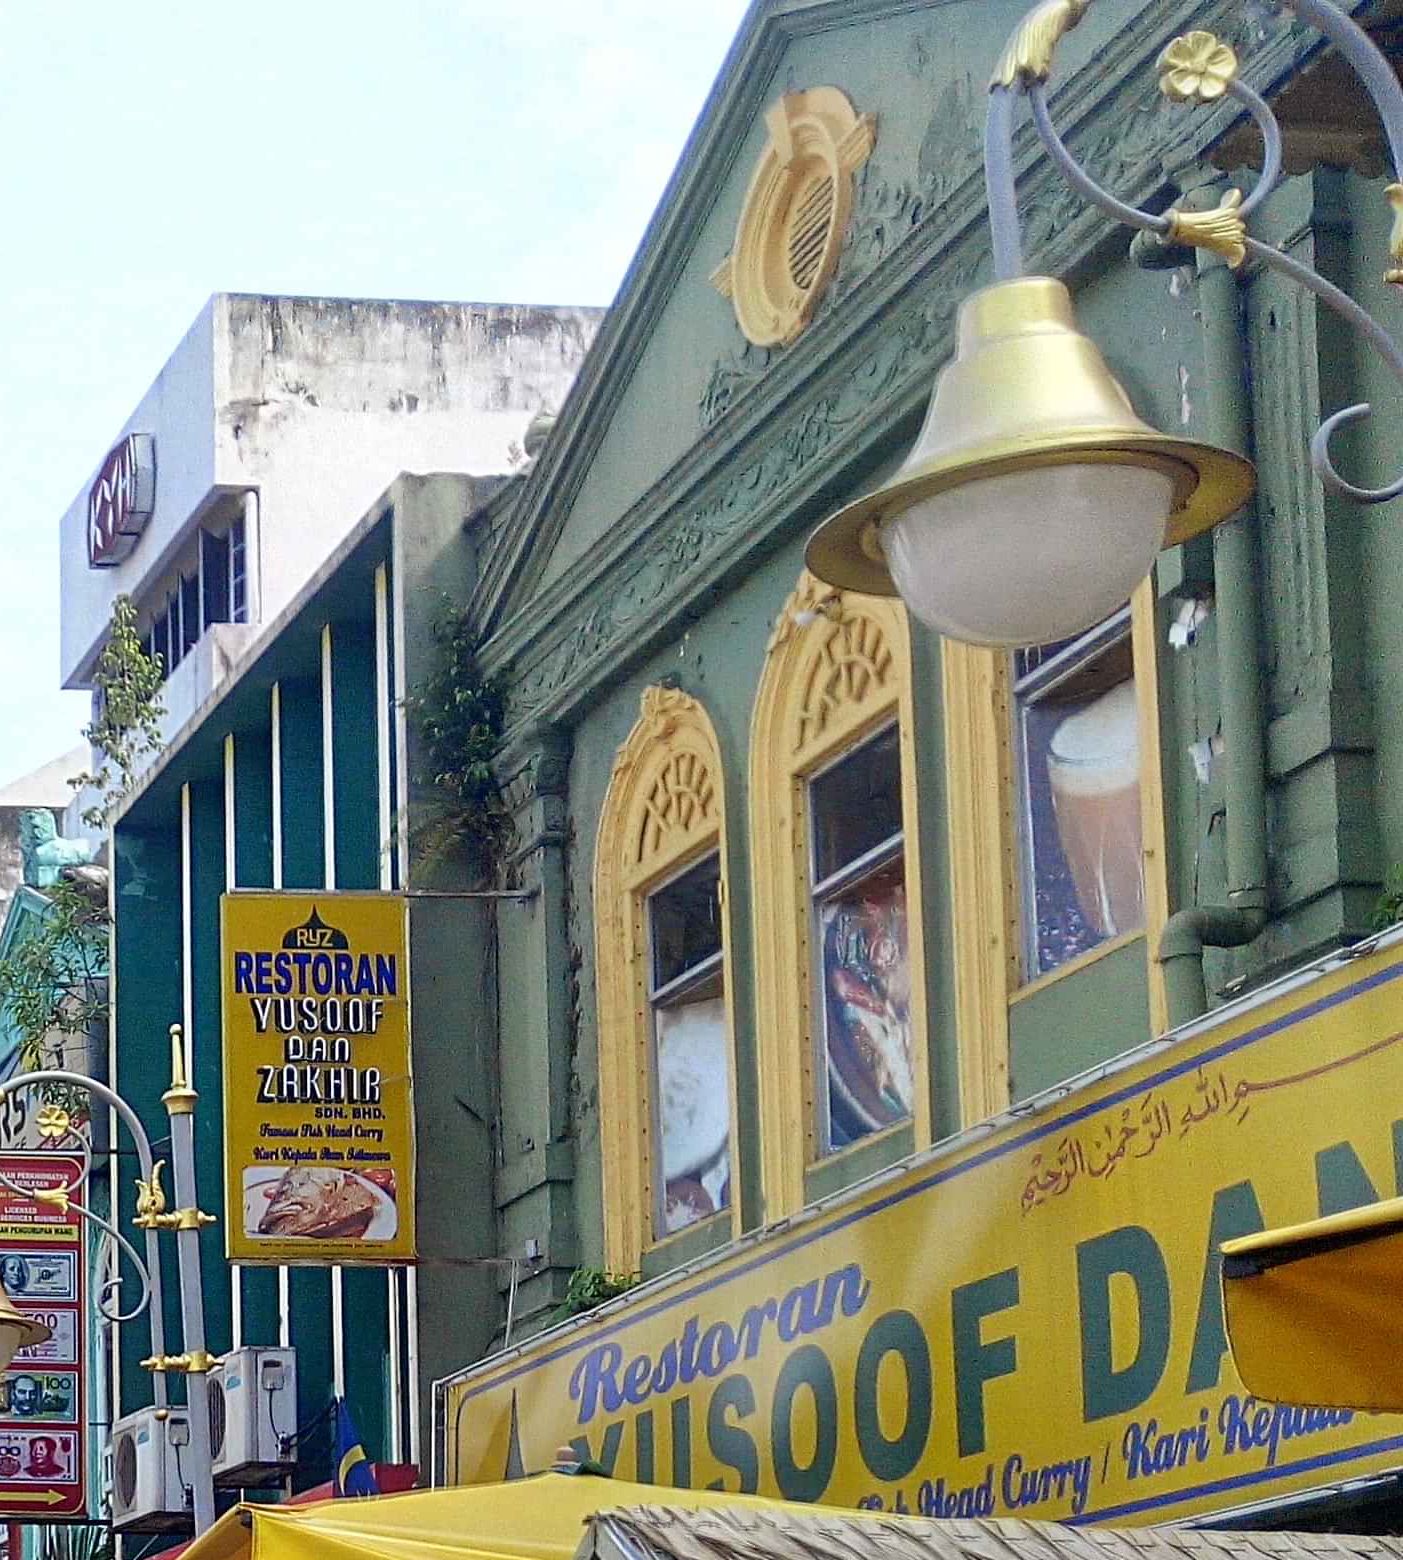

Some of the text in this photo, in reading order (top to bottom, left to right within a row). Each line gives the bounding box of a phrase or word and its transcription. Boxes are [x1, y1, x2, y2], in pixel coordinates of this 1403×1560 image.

[235, 952, 396, 995] RESTORAN
[252, 997, 384, 1033] YUSOOF
[287, 1036, 350, 1062] DAN
[258, 1064, 380, 1103] ZAKHIR
[315, 1108, 385, 1119] SDN. BHD.
[570, 1263, 871, 1424] Restoran
[1001, 1454, 1092, 1514] Curry
[1122, 1408, 1209, 1481] Kari
